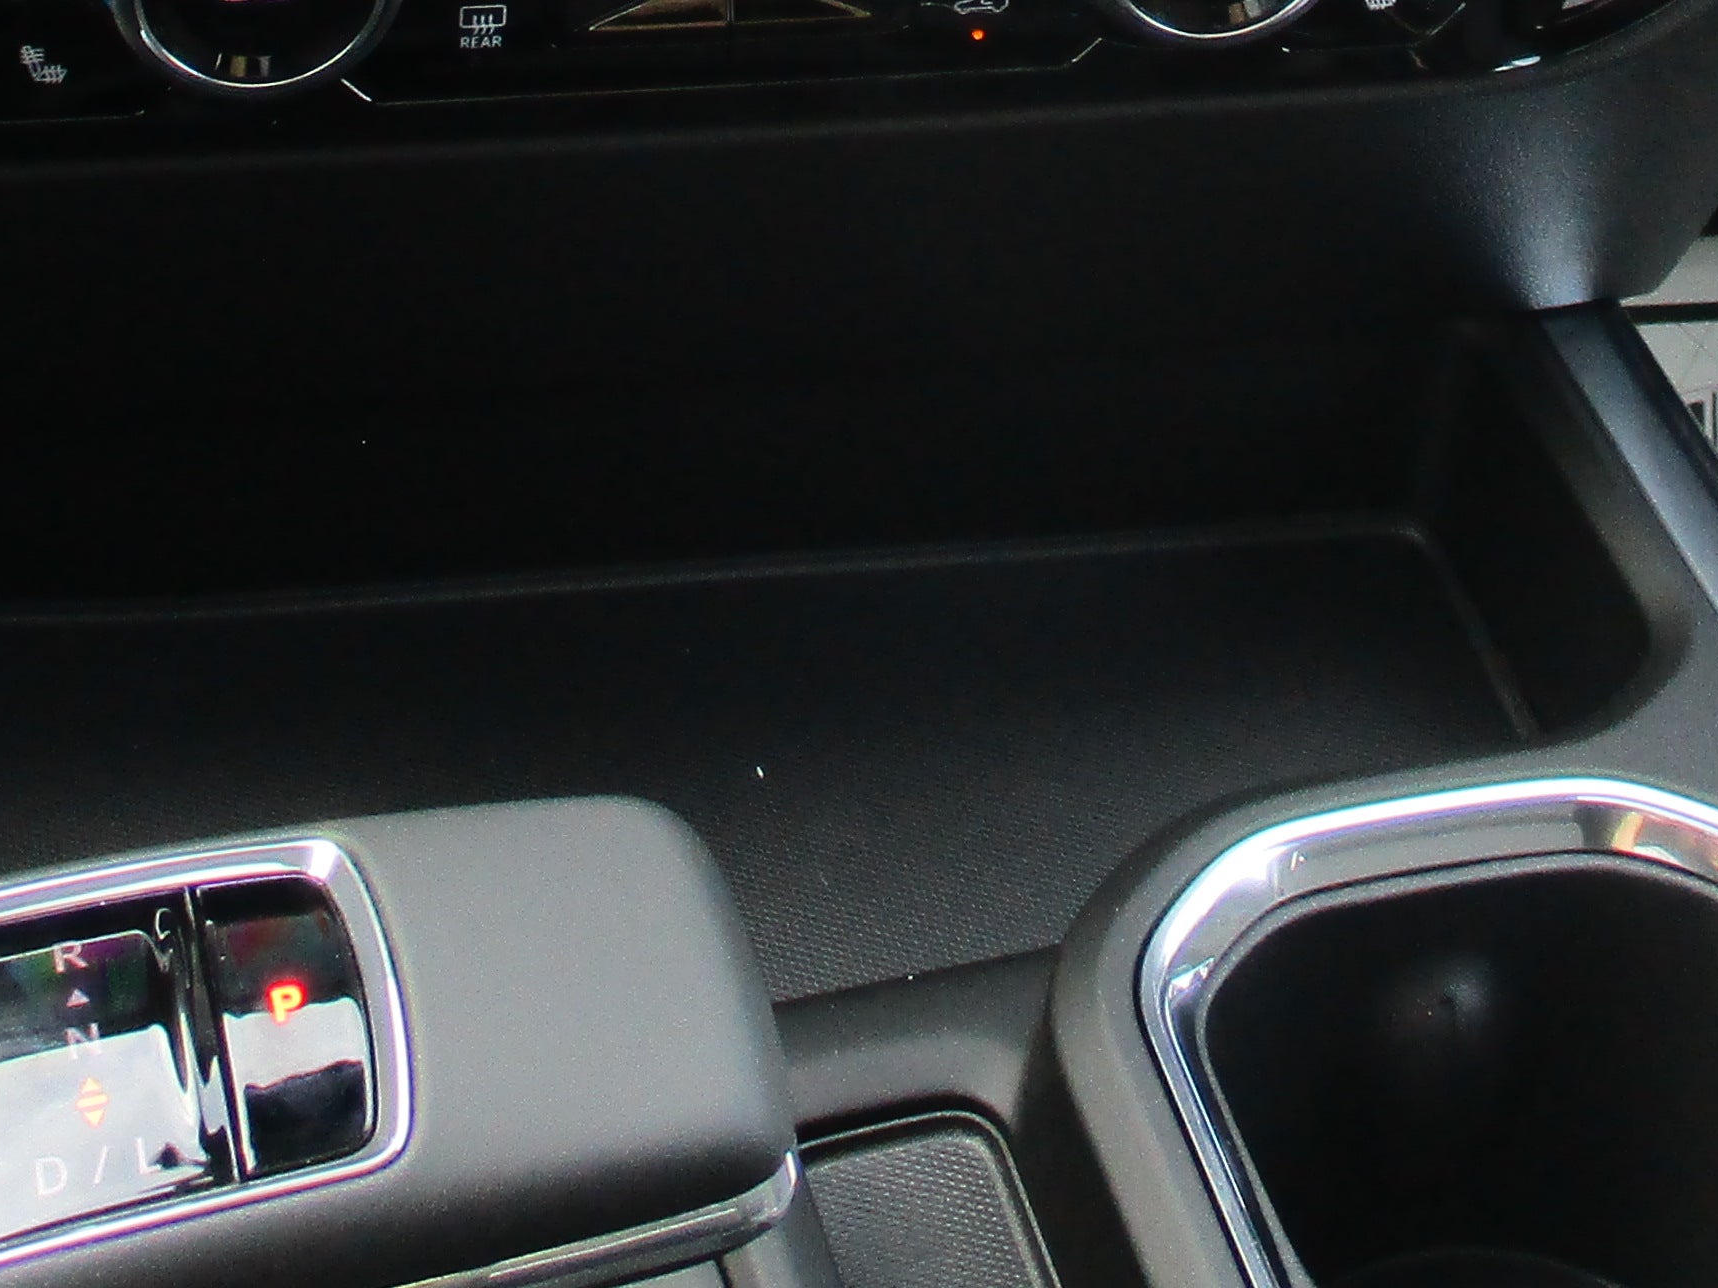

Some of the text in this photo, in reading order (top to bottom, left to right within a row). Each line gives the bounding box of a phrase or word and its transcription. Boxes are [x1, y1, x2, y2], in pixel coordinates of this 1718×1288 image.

[459, 35, 503, 49] REAR
[53, 941, 88, 974] R
[268, 982, 304, 1024] P
[66, 1024, 101, 1060] N
